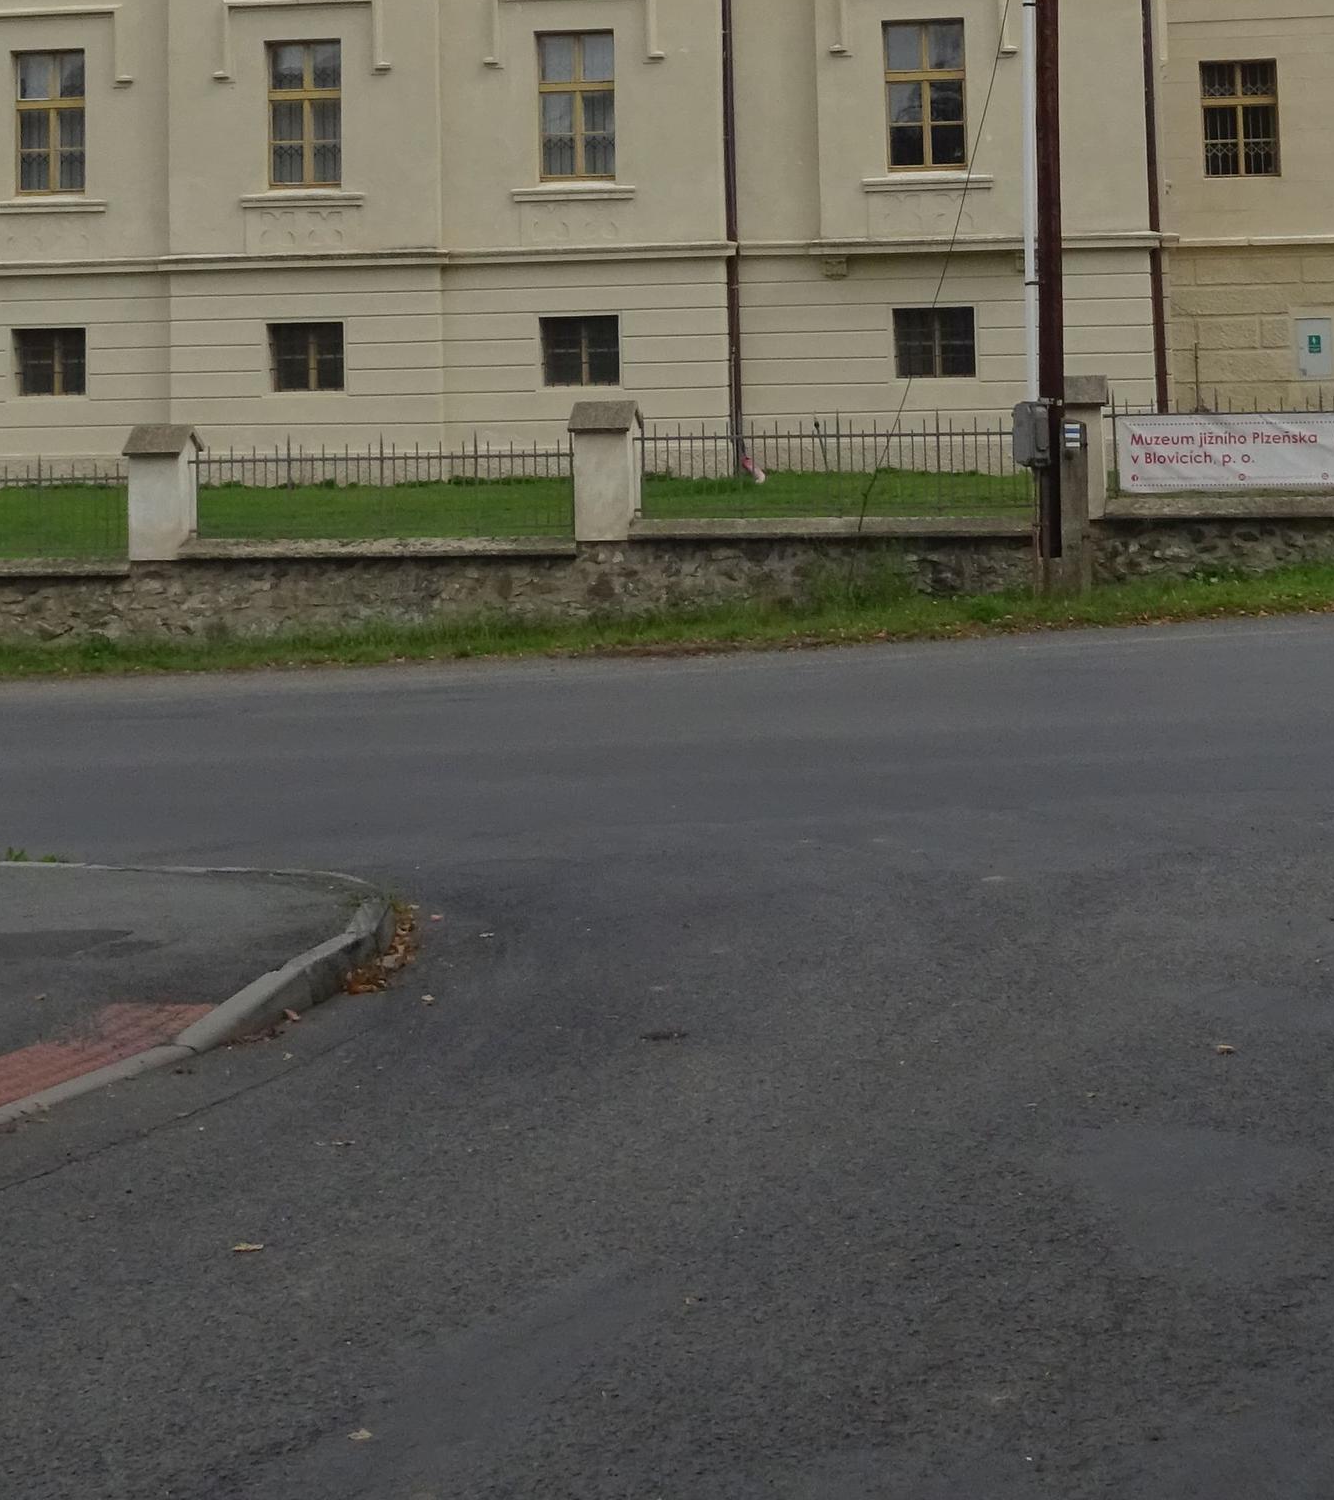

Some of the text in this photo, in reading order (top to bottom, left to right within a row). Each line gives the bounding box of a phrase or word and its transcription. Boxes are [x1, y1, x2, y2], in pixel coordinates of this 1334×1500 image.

[1130, 431, 1318, 447] Muzeum jižního Plzeňska
[1131, 455, 1140, 464] v
[1222, 453, 1236, 466] p.
[1241, 453, 1255, 464] o.
